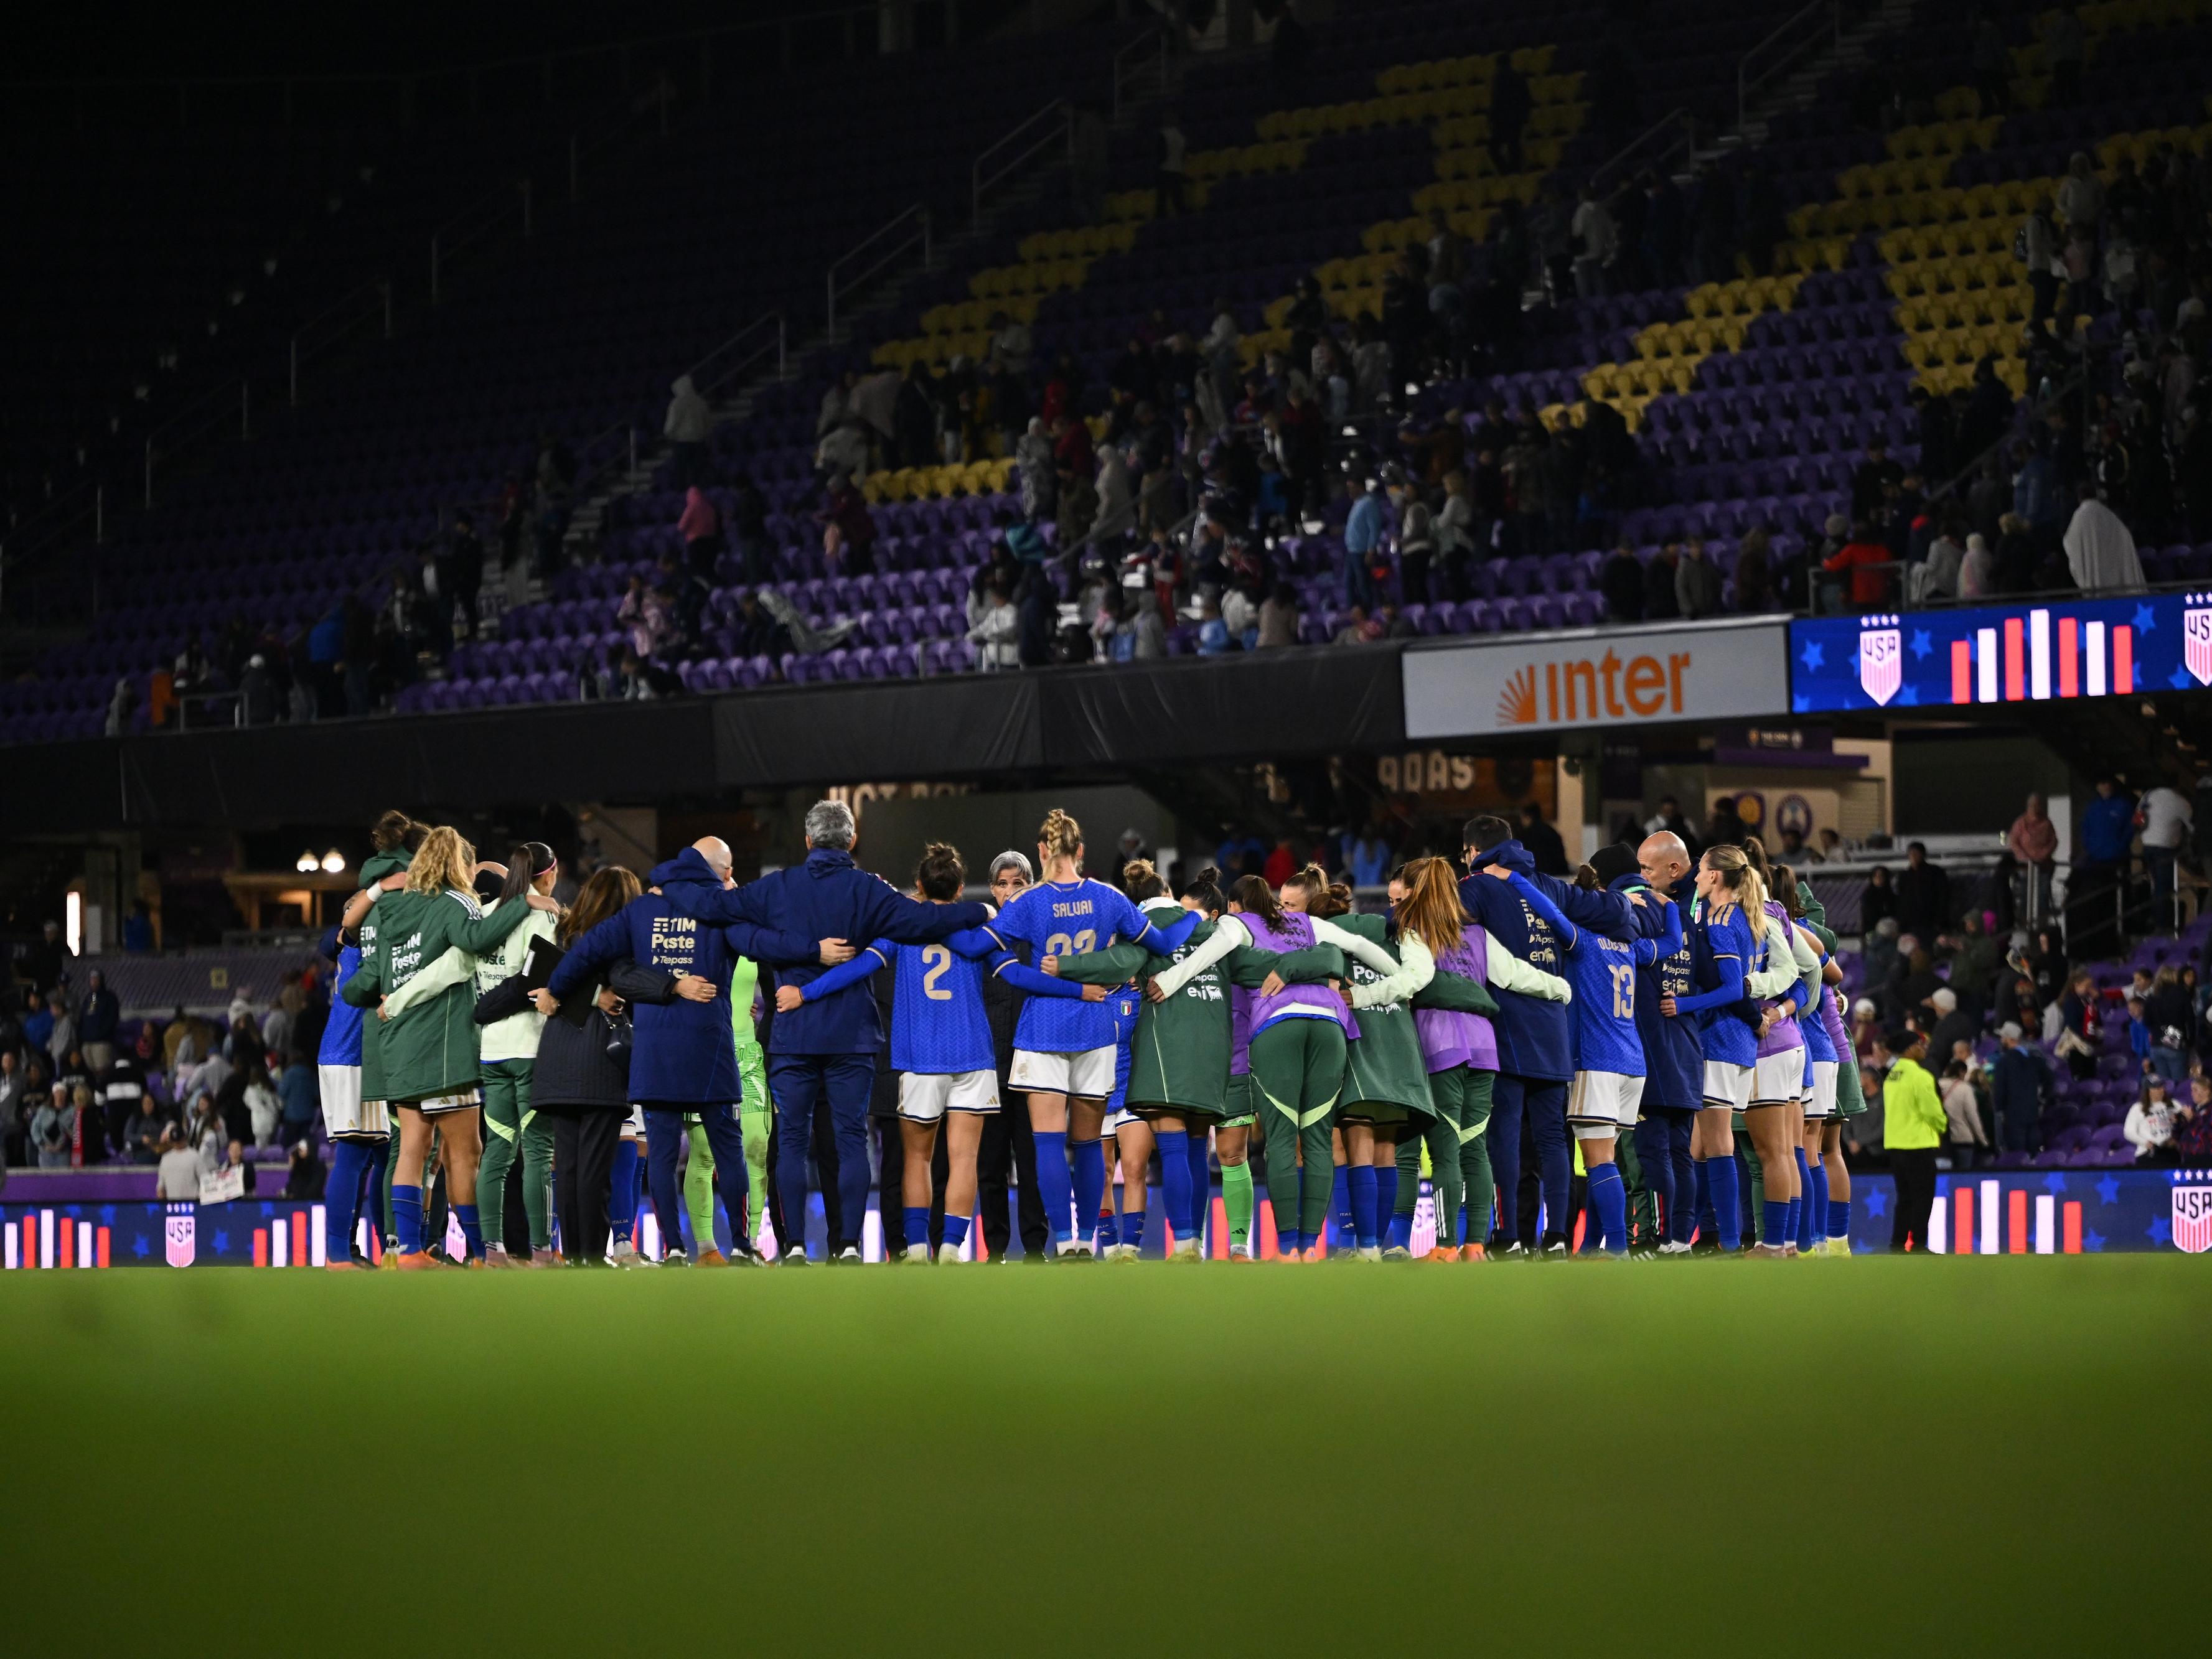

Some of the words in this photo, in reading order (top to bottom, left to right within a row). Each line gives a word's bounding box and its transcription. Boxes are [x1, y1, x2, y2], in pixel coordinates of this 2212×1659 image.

[1863, 636, 1896, 661] USA
[670, 917, 696, 932] TIM
[922, 943, 952, 1000] 2
[1608, 964, 1635, 1019] 13
[2177, 1192, 2212, 1220] USA
[168, 1221, 192, 1243] USA
